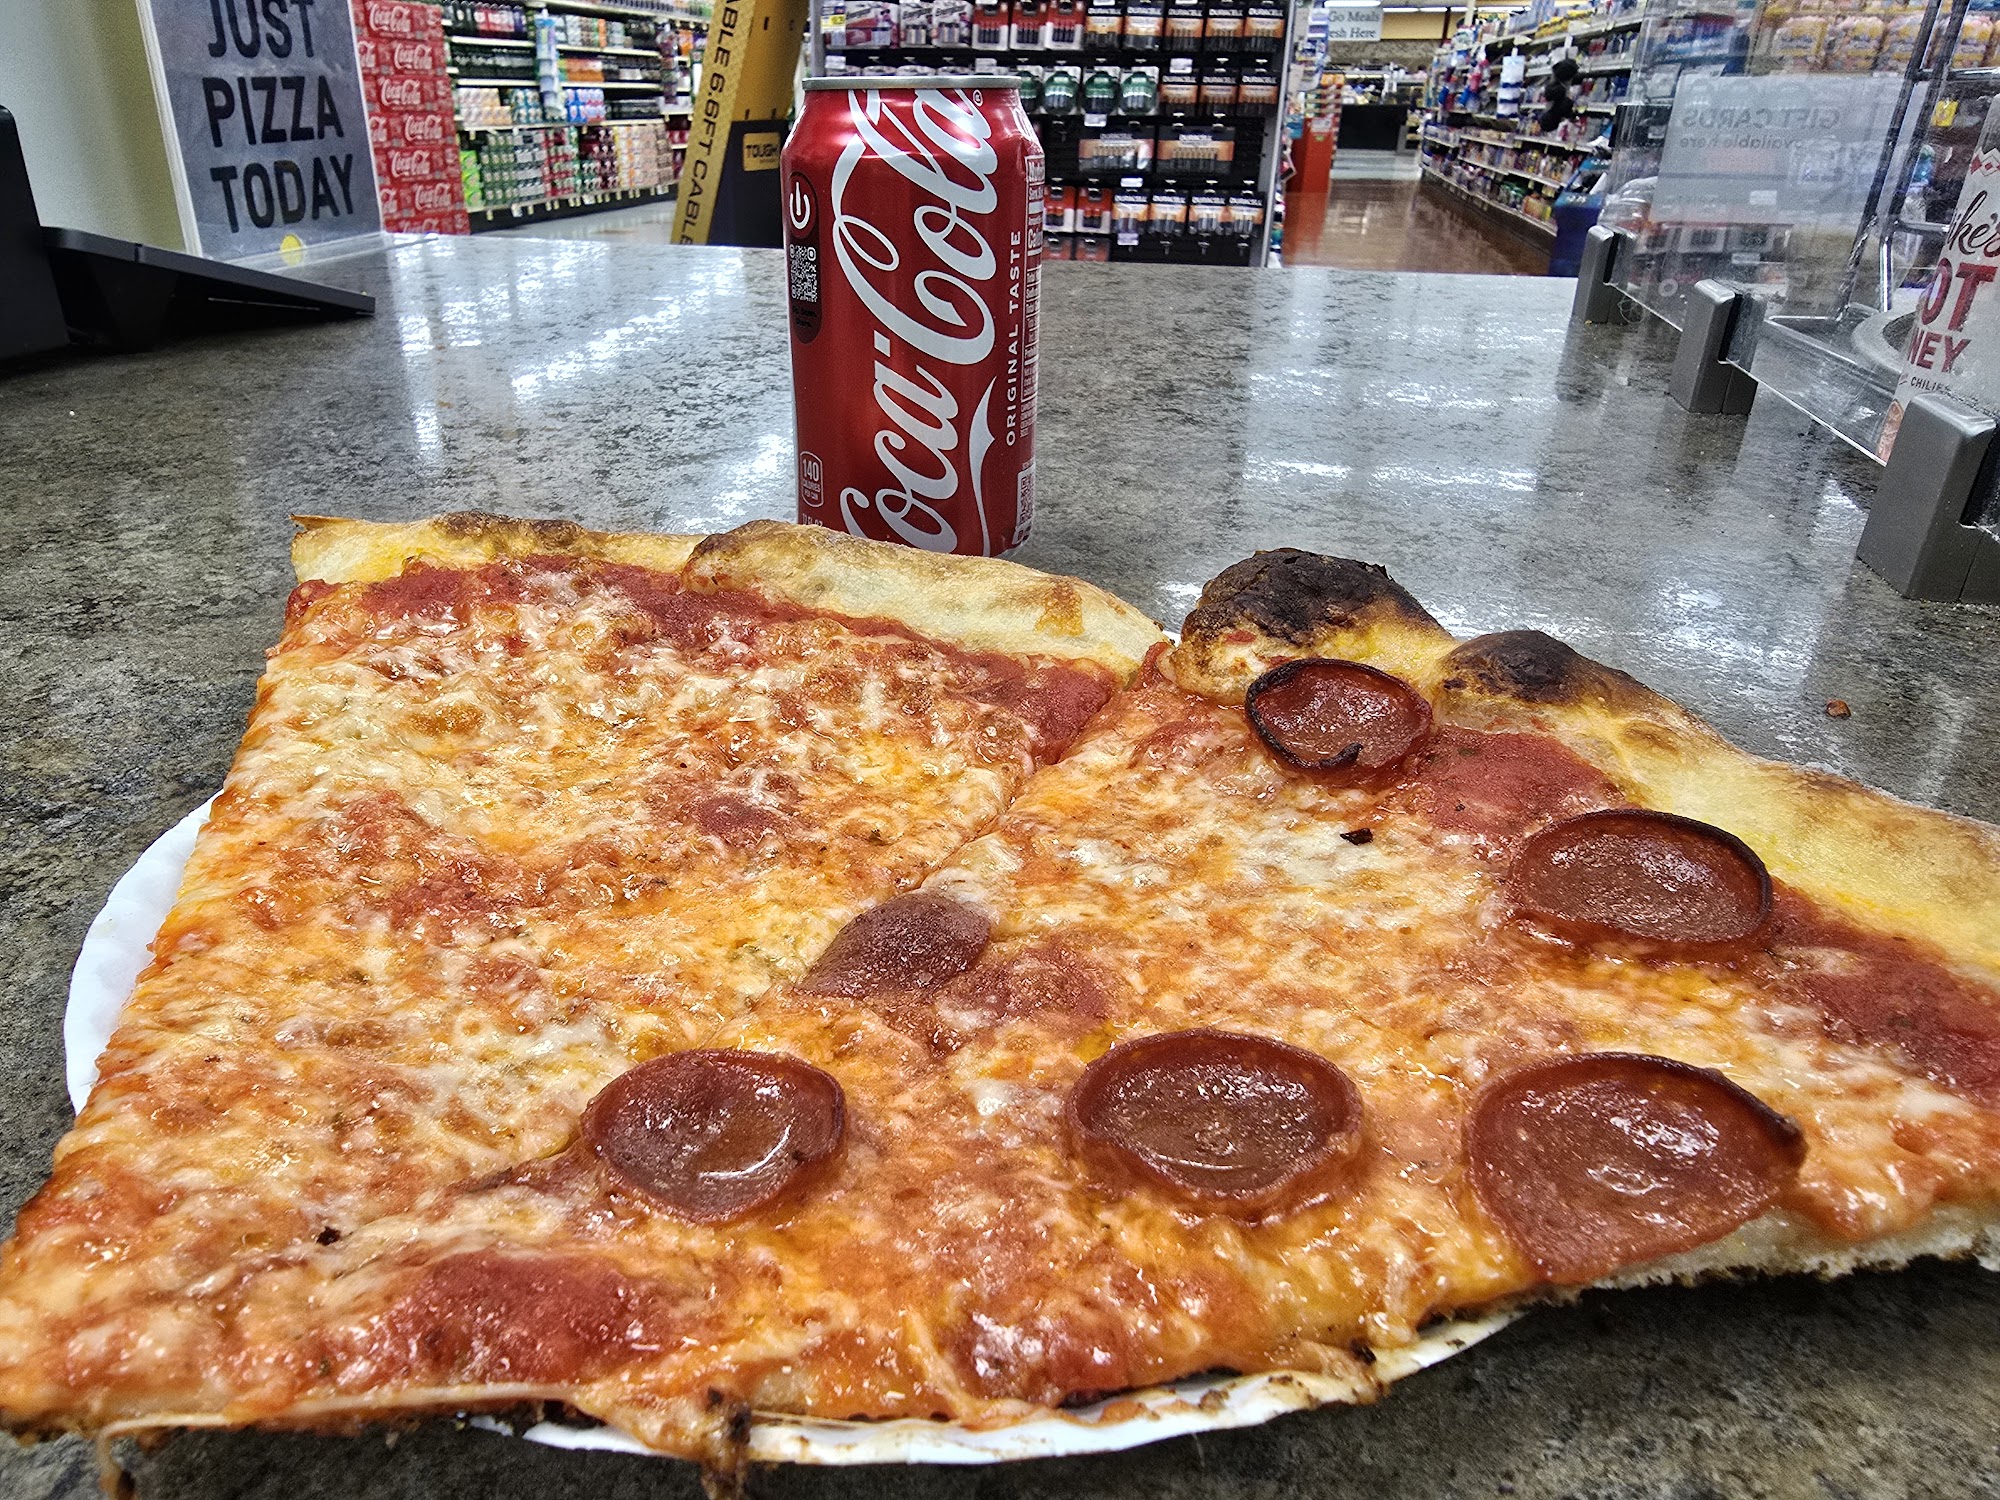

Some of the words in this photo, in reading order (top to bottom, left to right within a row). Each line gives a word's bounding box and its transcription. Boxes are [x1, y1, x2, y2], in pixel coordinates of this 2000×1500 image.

[208, 0, 314, 58] JUST
[713, 0, 739, 68] BLE
[1329, 27, 1347, 38] esh
[1350, 27, 1376, 39] Here
[1347, 11, 1380, 22] Meals
[202, 75, 344, 148] PIZZA
[699, 72, 726, 156] 6.6FT
[210, 153, 353, 233] TODAY
[680, 159, 708, 245] CABLE
[1009, 231, 1021, 314] TASTE
[1921, 257, 1998, 332] OT
[1006, 324, 1019, 446] ORIGINAL
[1907, 329, 1972, 373] NEY
[803, 458, 819, 481] 140
